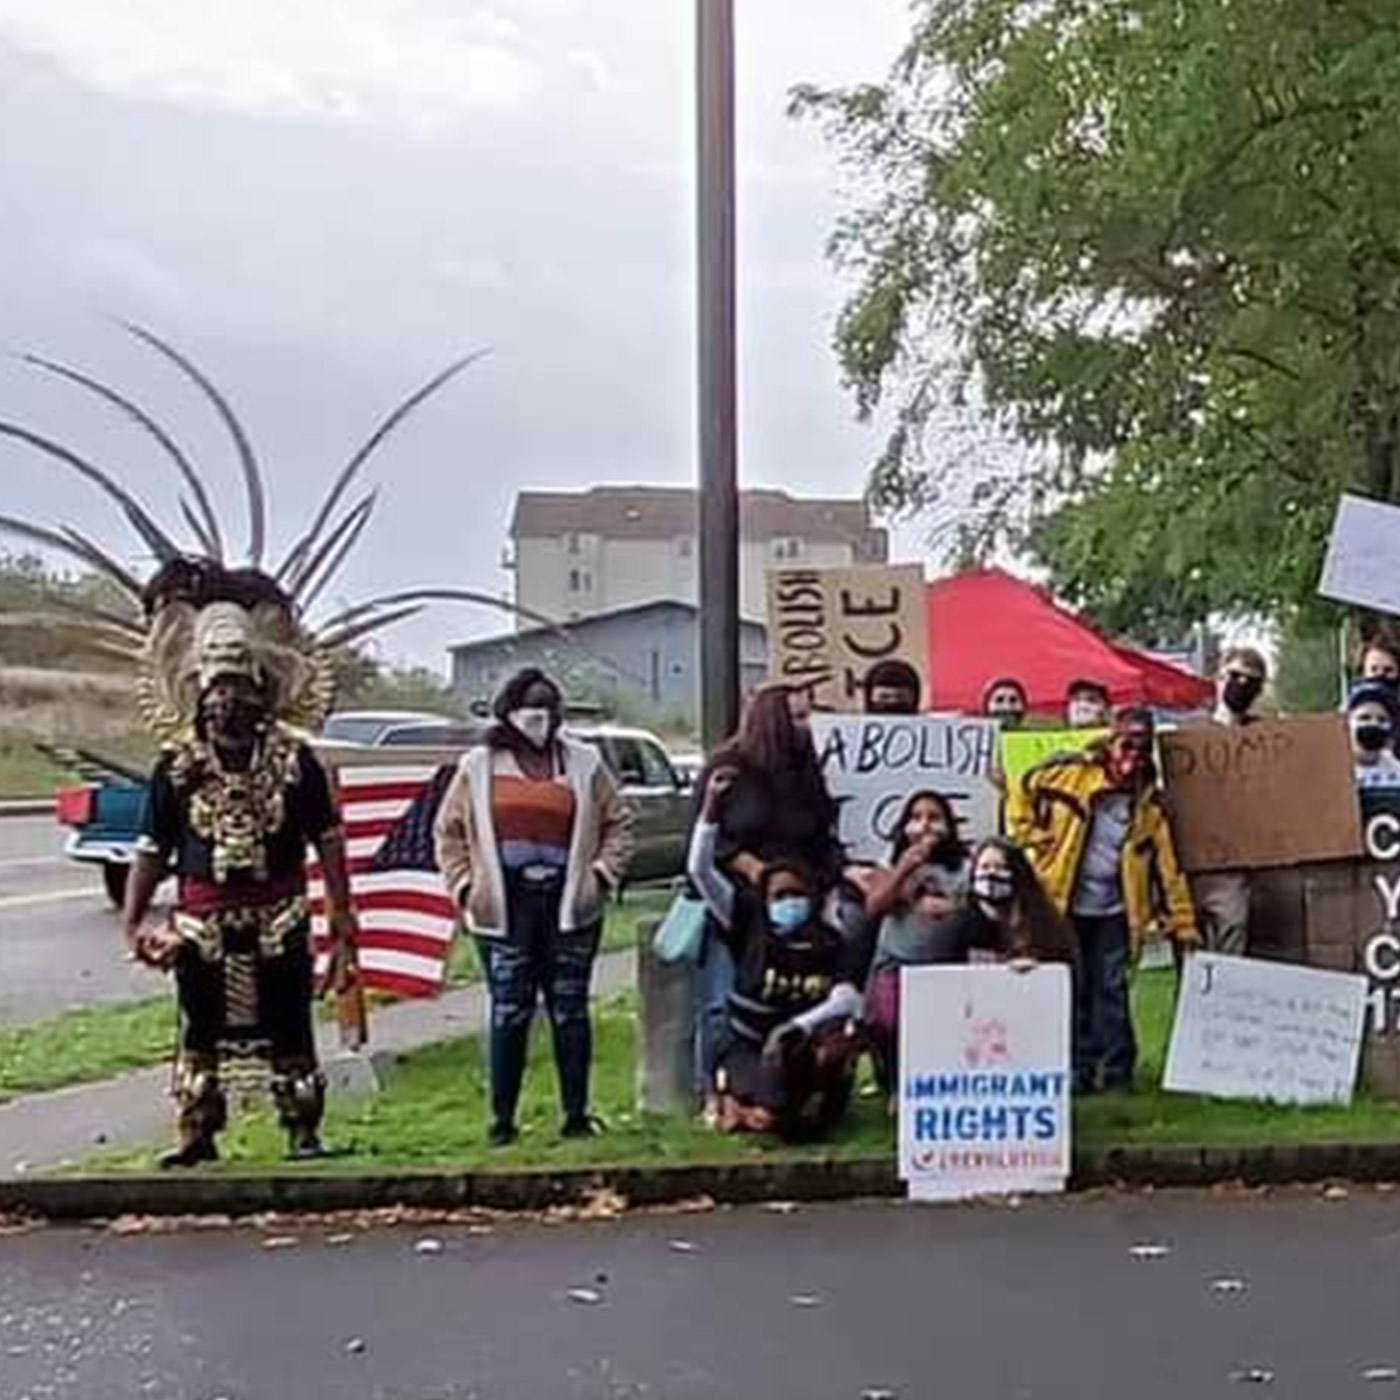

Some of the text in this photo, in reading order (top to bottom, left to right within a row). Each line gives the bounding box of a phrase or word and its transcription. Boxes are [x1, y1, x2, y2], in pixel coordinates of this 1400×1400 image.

[818, 721, 994, 776] ABOLISH
[1168, 736, 1294, 777] DUMP
[907, 1073, 1066, 1098] IMMIGRANT
[914, 1105, 1056, 1140] RIGHTS
